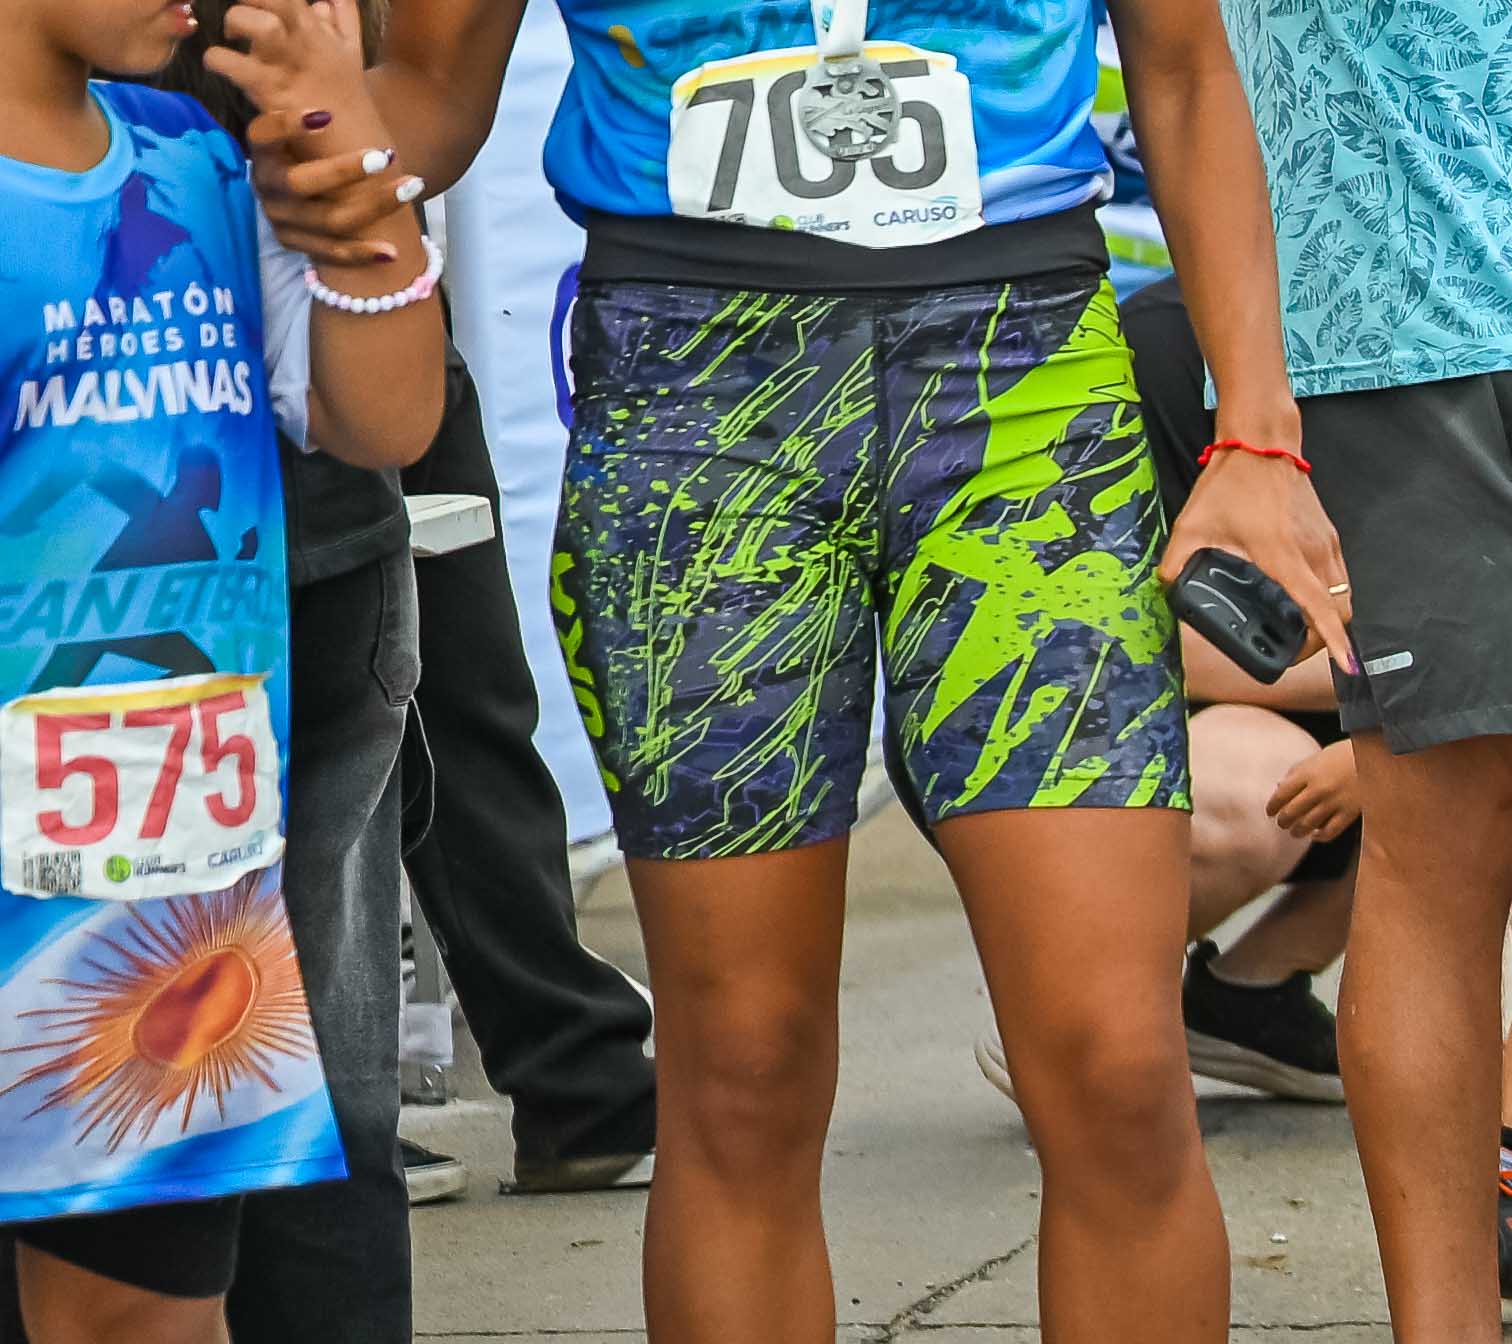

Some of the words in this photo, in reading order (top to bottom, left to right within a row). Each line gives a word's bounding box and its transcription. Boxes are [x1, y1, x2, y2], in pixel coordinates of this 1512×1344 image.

[687, 58, 947, 212] 705
[873, 205, 956, 228] CARUSO
[43, 281, 235, 334] MARATÓN
[200, 322, 237, 349] DE
[14, 358, 253, 432] MALVINAS
[37, 690, 257, 846] 575
